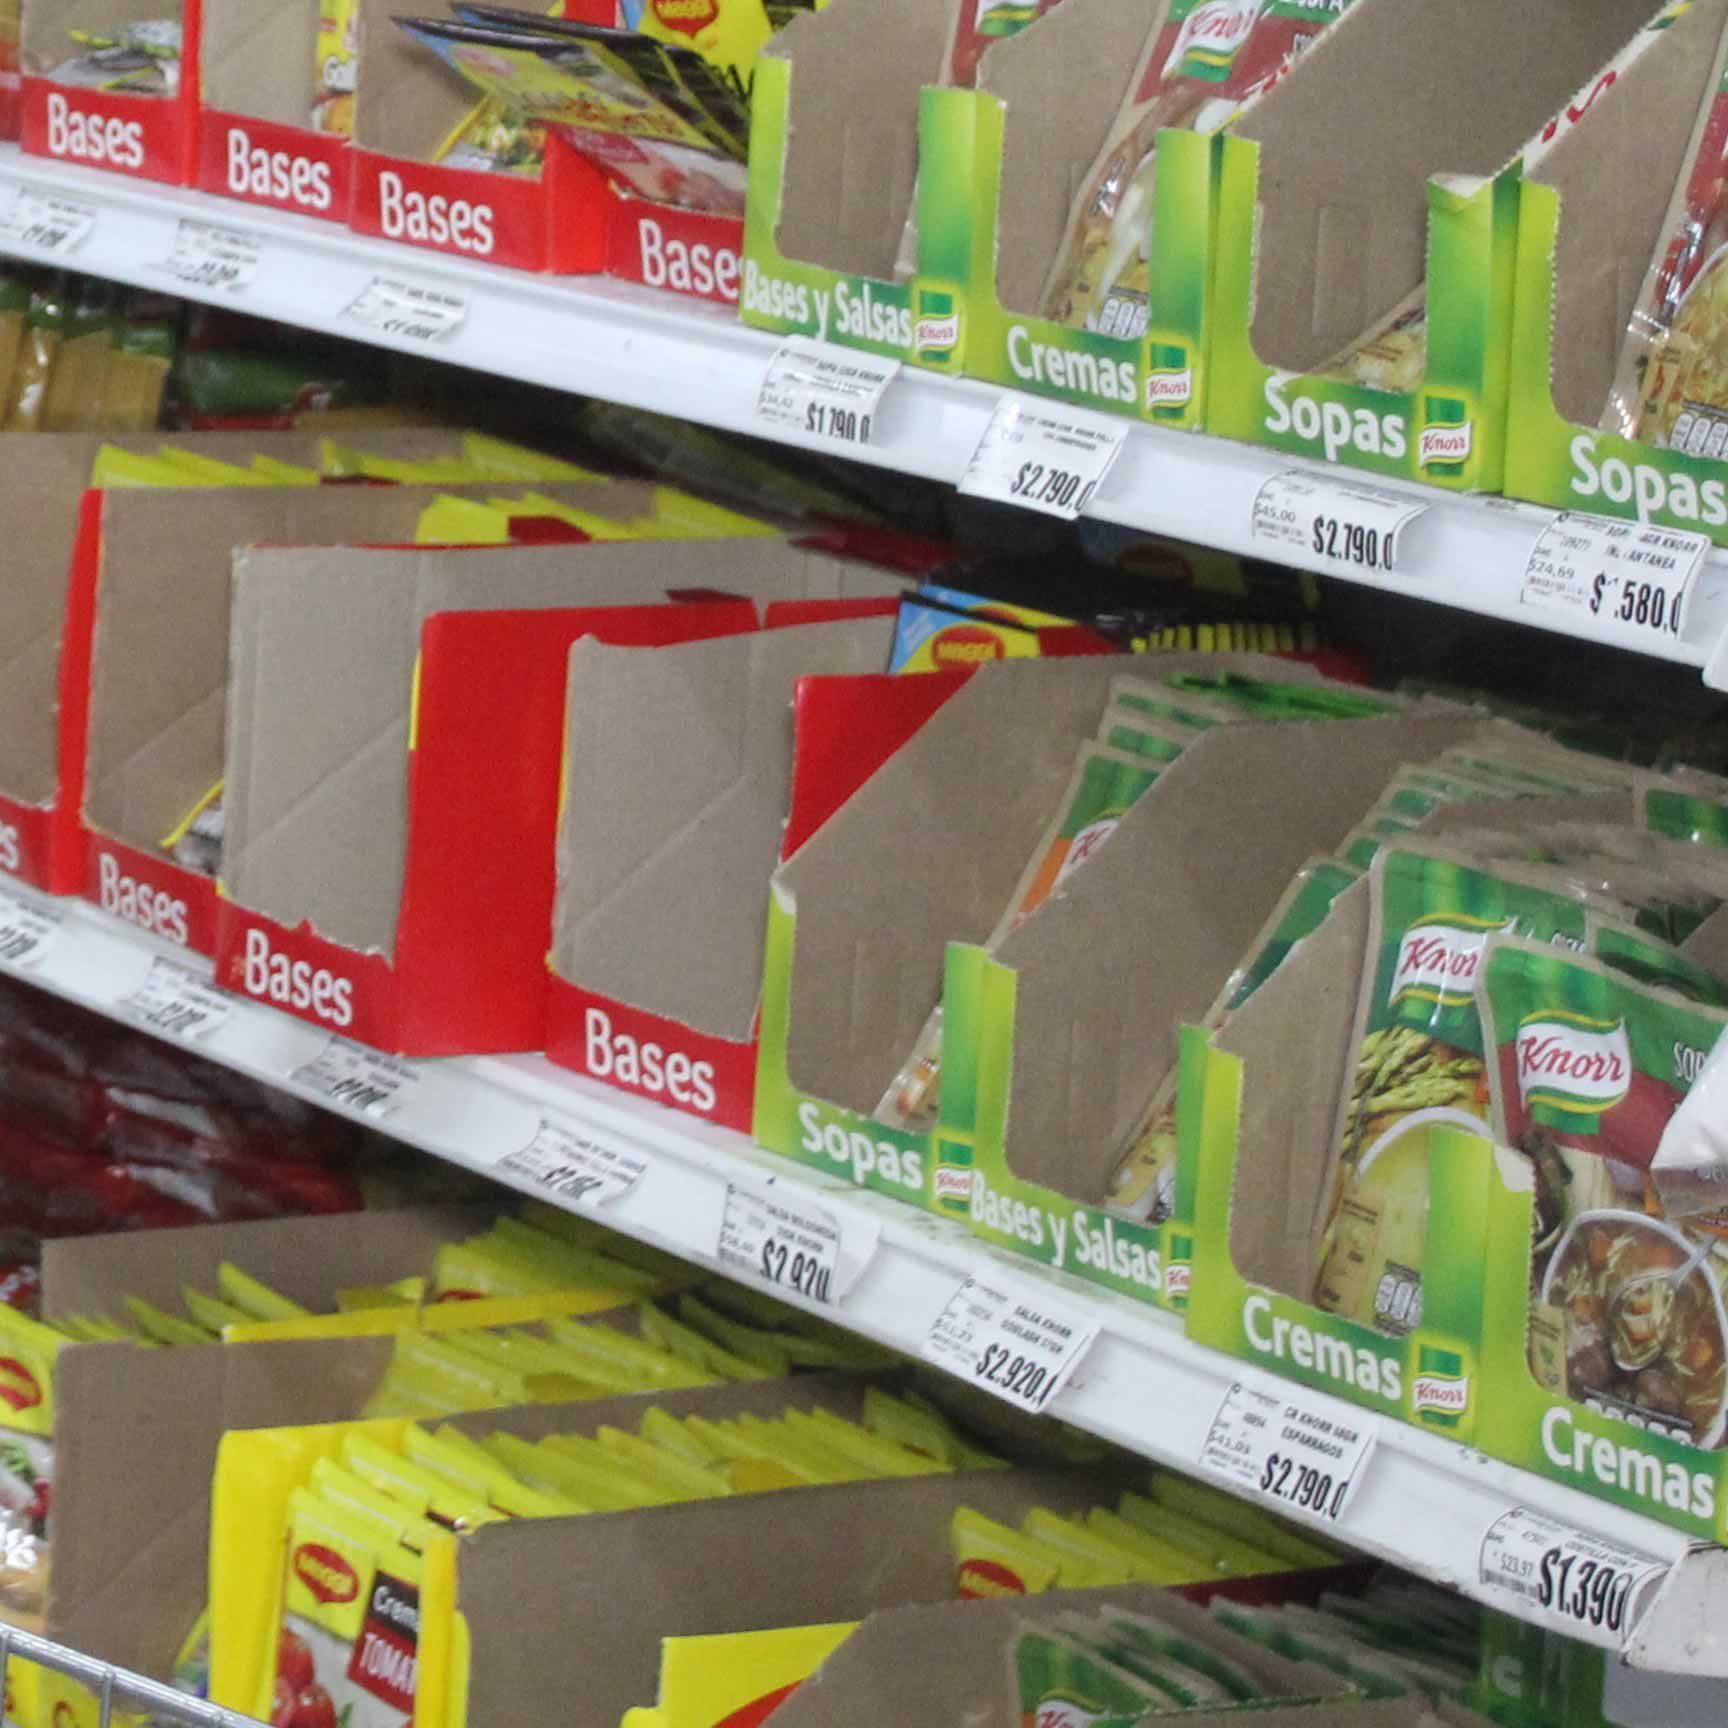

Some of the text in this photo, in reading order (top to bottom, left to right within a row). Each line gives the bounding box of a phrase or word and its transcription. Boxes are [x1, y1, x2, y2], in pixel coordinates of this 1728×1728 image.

[46, 92, 144, 169] Bases
[227, 128, 332, 210] Bases
[379, 170, 496, 255] Bases
[744, 257, 912, 349] Bases y Salsas
[917, 321, 956, 343] Knorr
[1007, 324, 1139, 404] Cremas
[1149, 375, 1189, 400] Knorr
[1263, 371, 1407, 462] Sopas
[1420, 425, 1468, 453] Knorr
[1569, 434, 1728, 525] Sopas
[1605, 544, 1678, 571] INANTANEA
[1661, 534, 1699, 554] KNORR
[99, 851, 190, 949] Bases
[244, 926, 354, 1029] Bases
[583, 1006, 718, 1112] Bases
[1520, 1035, 1625, 1083] Knorr
[797, 1101, 925, 1189] Sopas
[971, 1167, 1162, 1292] Bases y Salsas
[1242, 1294, 1402, 1403] Cremas
[1299, 1412, 1333, 1435] KNORR
[1415, 1377, 1465, 1405] Knorr
[1280, 1425, 1344, 1459] ESPARRAGOS
[1541, 1406, 1715, 1521] Cremas
[1538, 1544, 1634, 1632] $1.390
